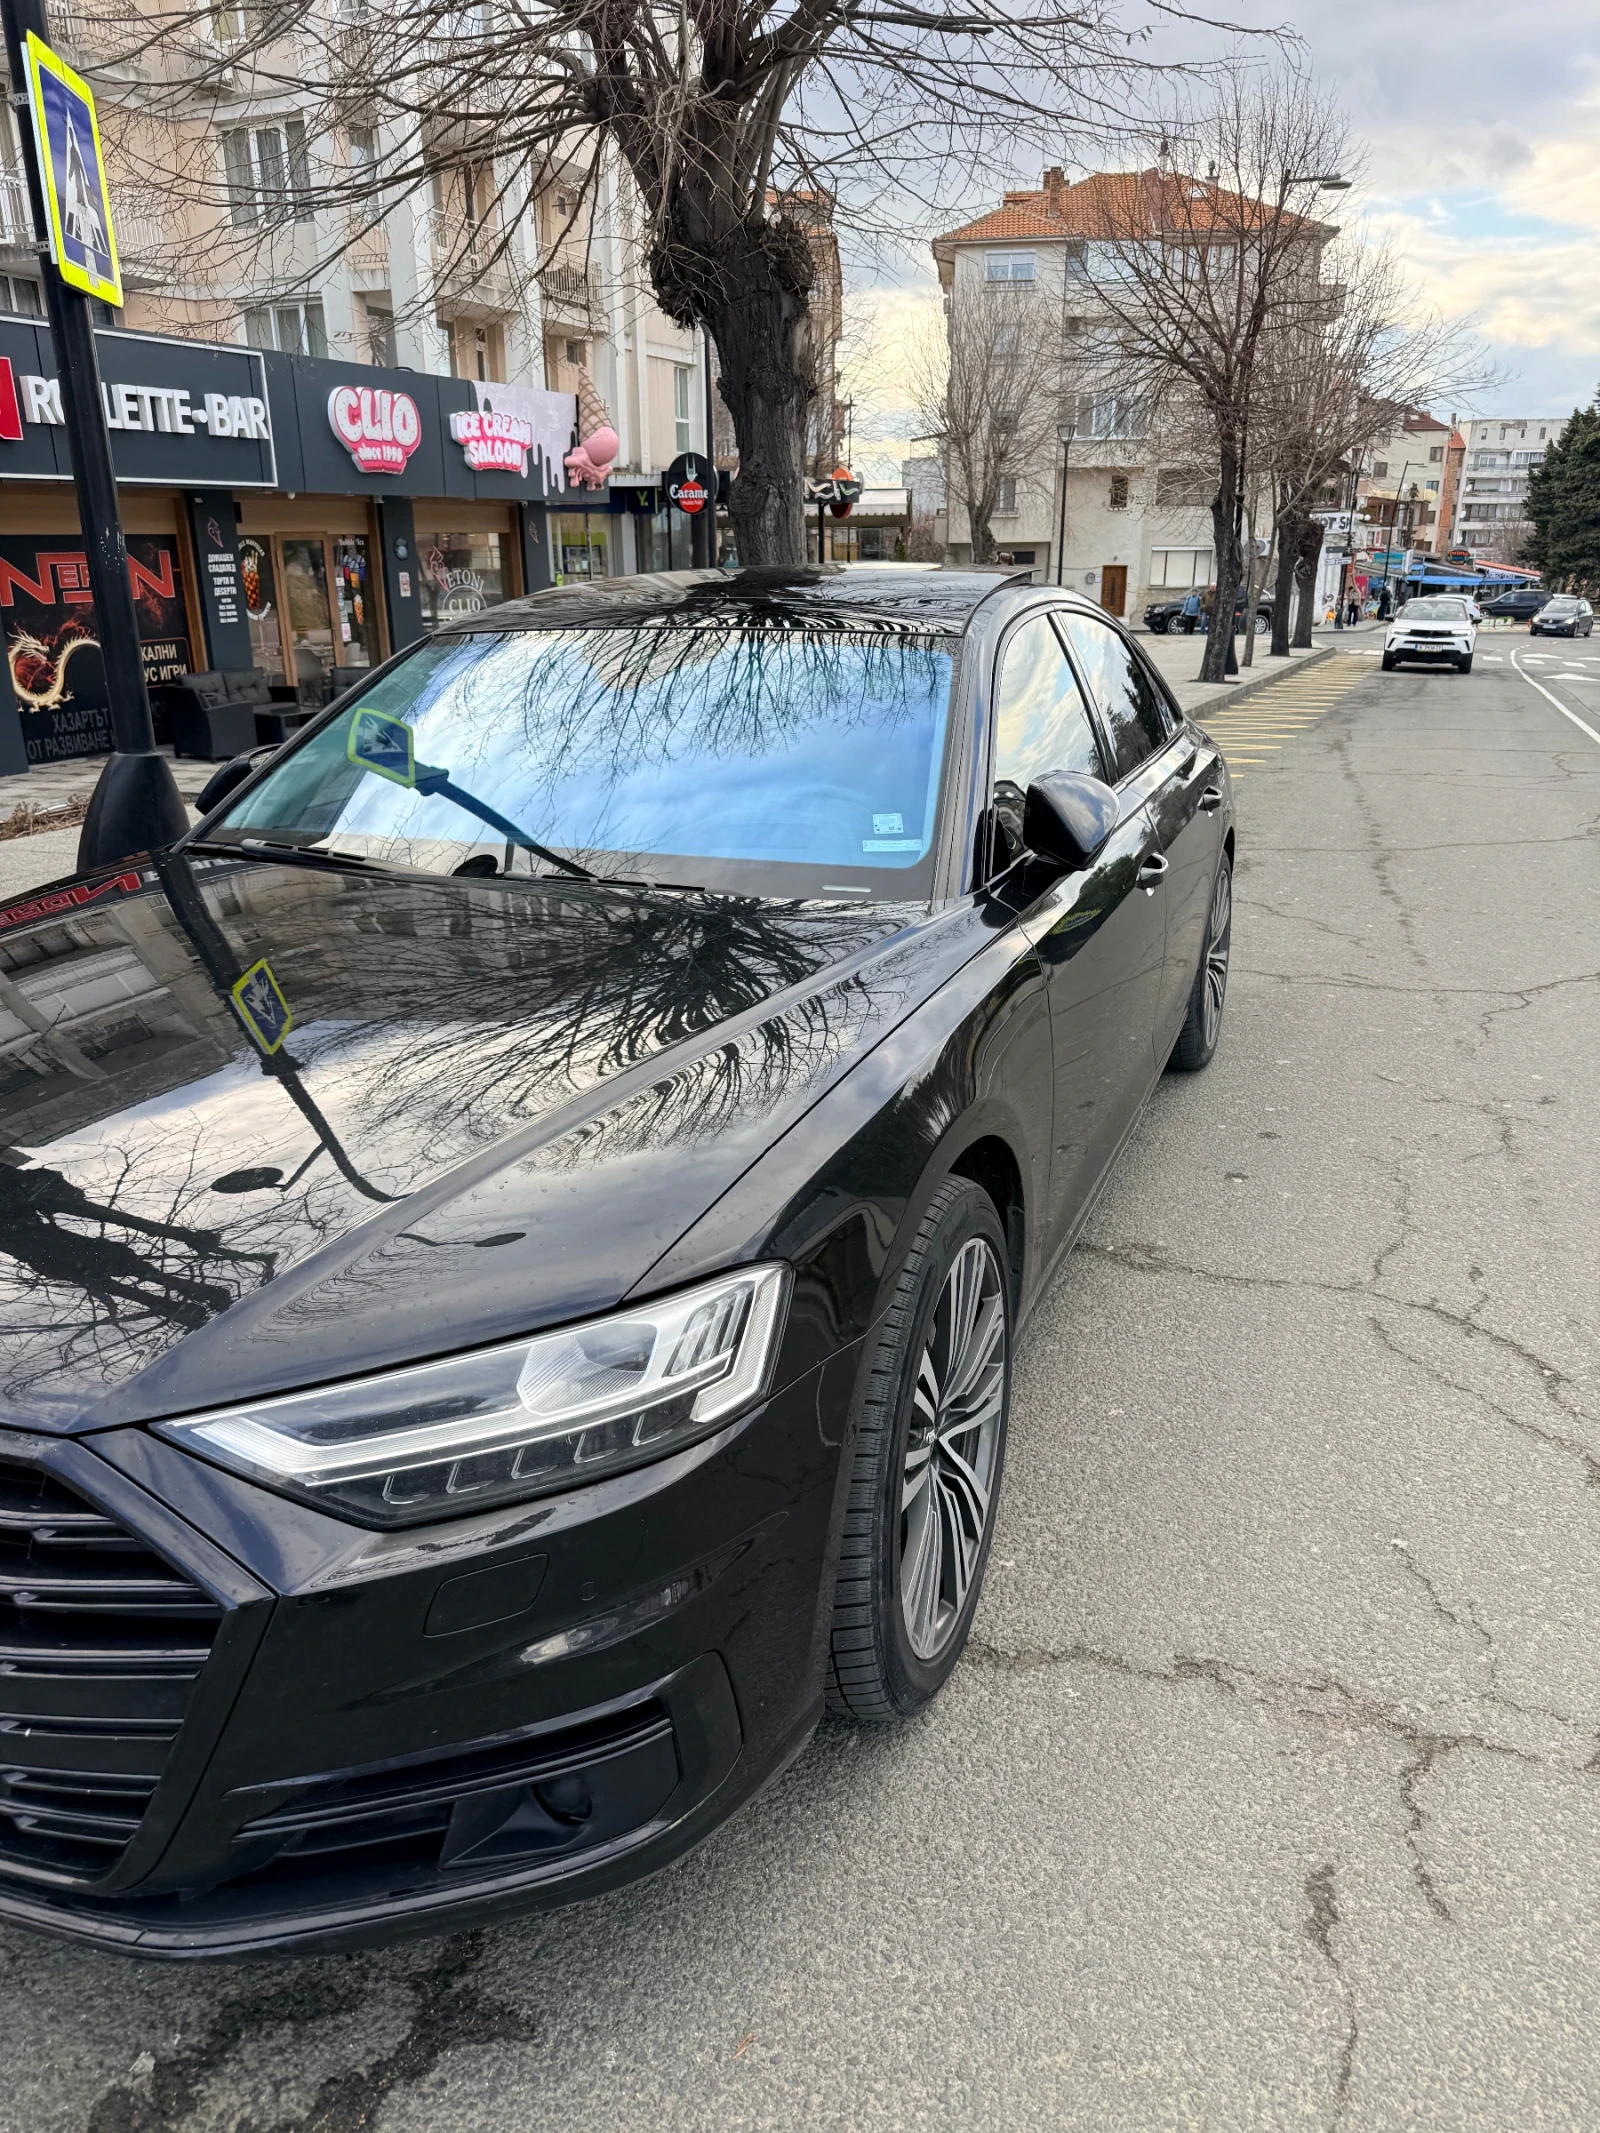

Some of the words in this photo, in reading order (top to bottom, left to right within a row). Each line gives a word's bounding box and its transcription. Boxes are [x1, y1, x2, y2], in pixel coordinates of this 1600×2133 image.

[331, 386, 420, 446] CLIO
[455, 412, 481, 439] ICE
[483, 412, 532, 446] CREAM
[468, 439, 522, 467] SALOON
[670, 484, 709, 499] Carame
[449, 597, 480, 614] CLIO
[141, 643, 178, 662] КАЛНИ
[159, 663, 188, 681] ИГРИ
[52, 707, 110, 735] ХАЗАРТЪТ
[27, 739, 42, 760] ОТ
[44, 729, 111, 756] РАЗВИВАНЕ
